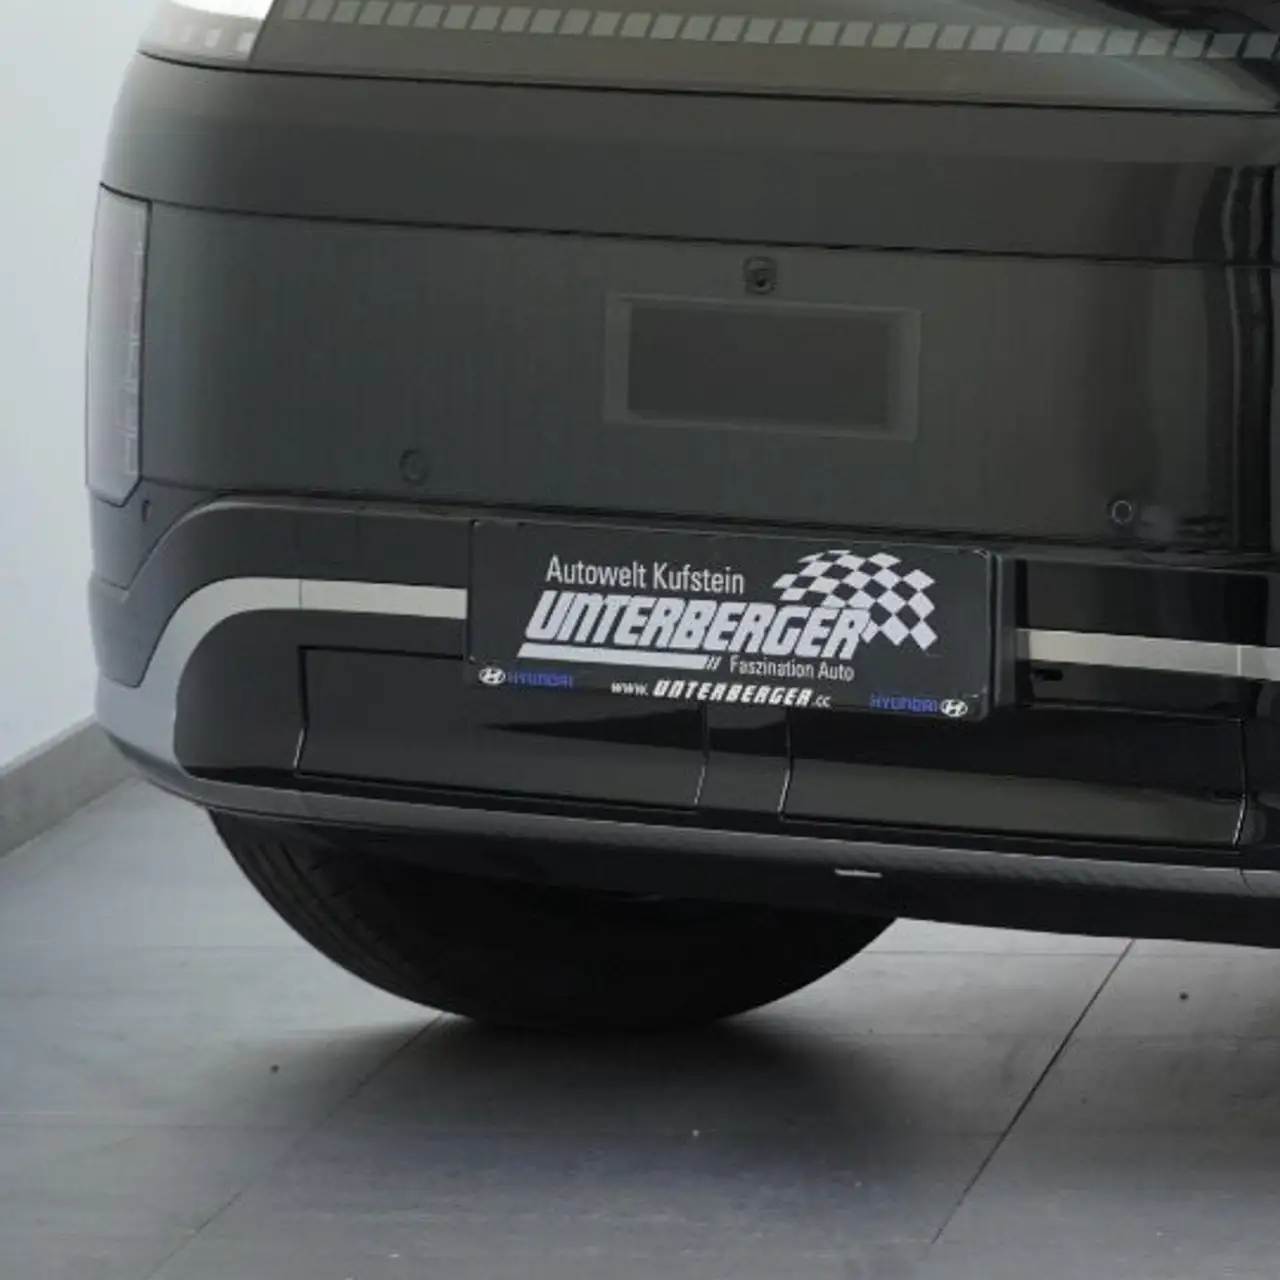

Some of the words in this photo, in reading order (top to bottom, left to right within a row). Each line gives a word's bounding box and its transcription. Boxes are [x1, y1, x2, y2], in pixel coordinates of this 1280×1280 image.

[546, 554, 647, 590] Autowelt
[652, 561, 745, 595] Kufstein
[525, 589, 871, 662] UNTERBERGER
[730, 656, 815, 679] Faszination
[817, 660, 855, 682] Auto
